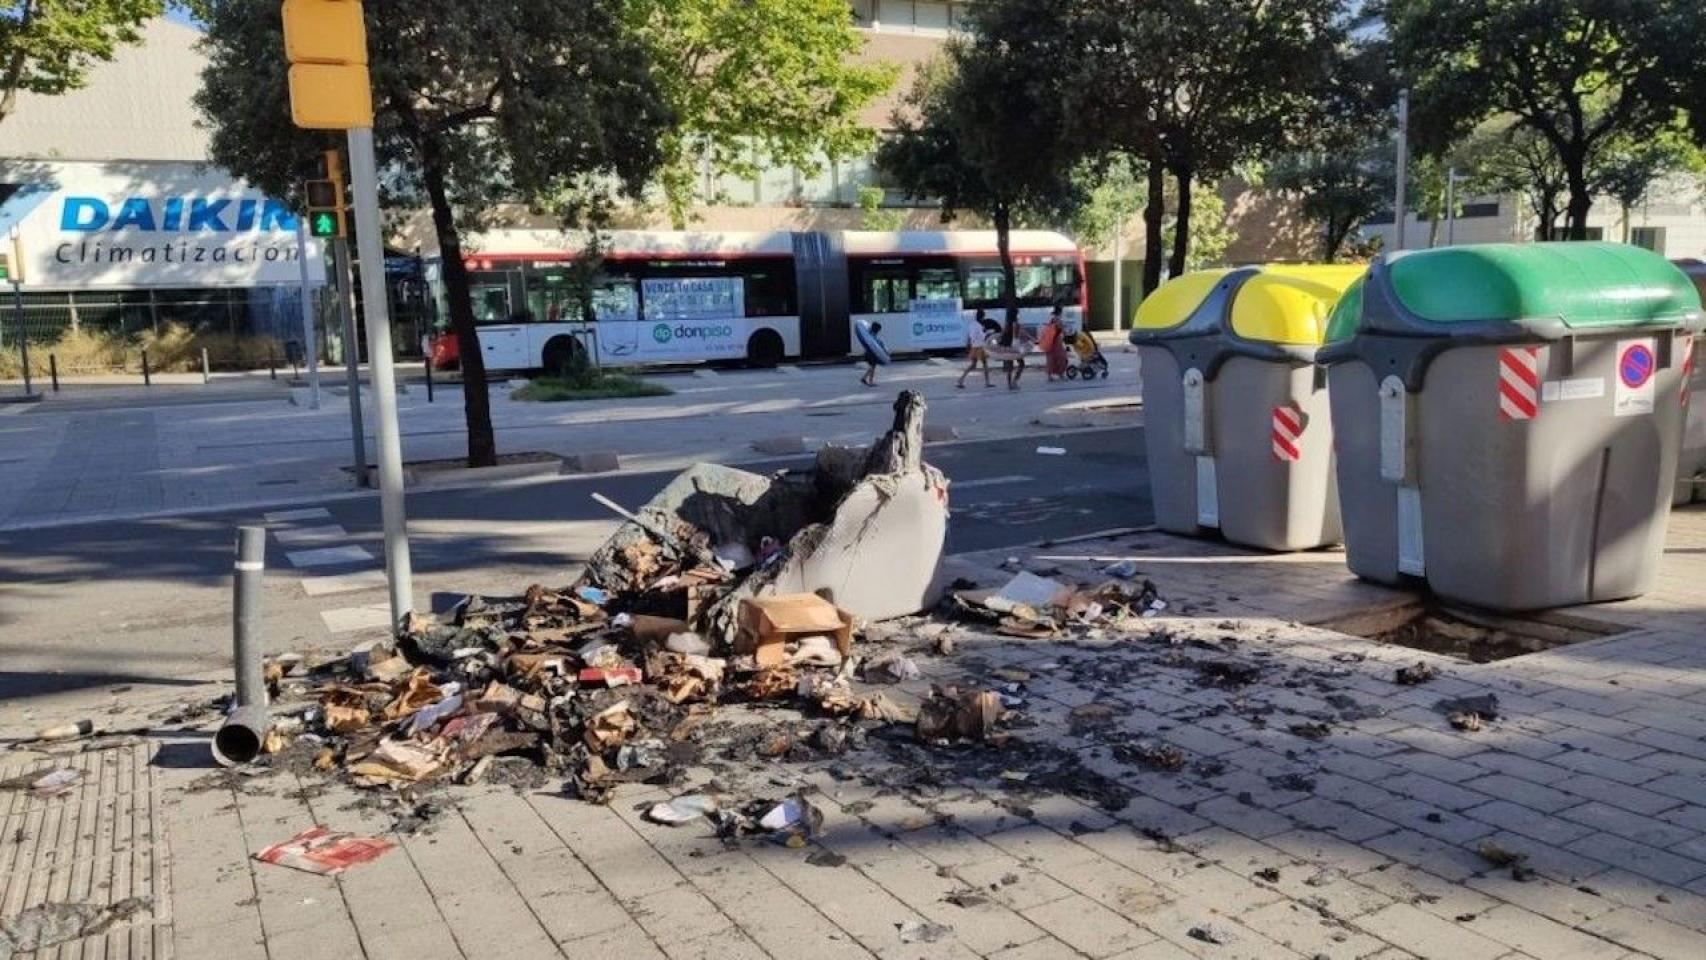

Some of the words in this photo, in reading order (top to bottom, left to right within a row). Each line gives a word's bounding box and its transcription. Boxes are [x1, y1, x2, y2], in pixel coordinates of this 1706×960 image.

[60, 196, 298, 231] DAIKIN
[55, 240, 300, 263] Climatización
[674, 324, 732, 341] donpiso
